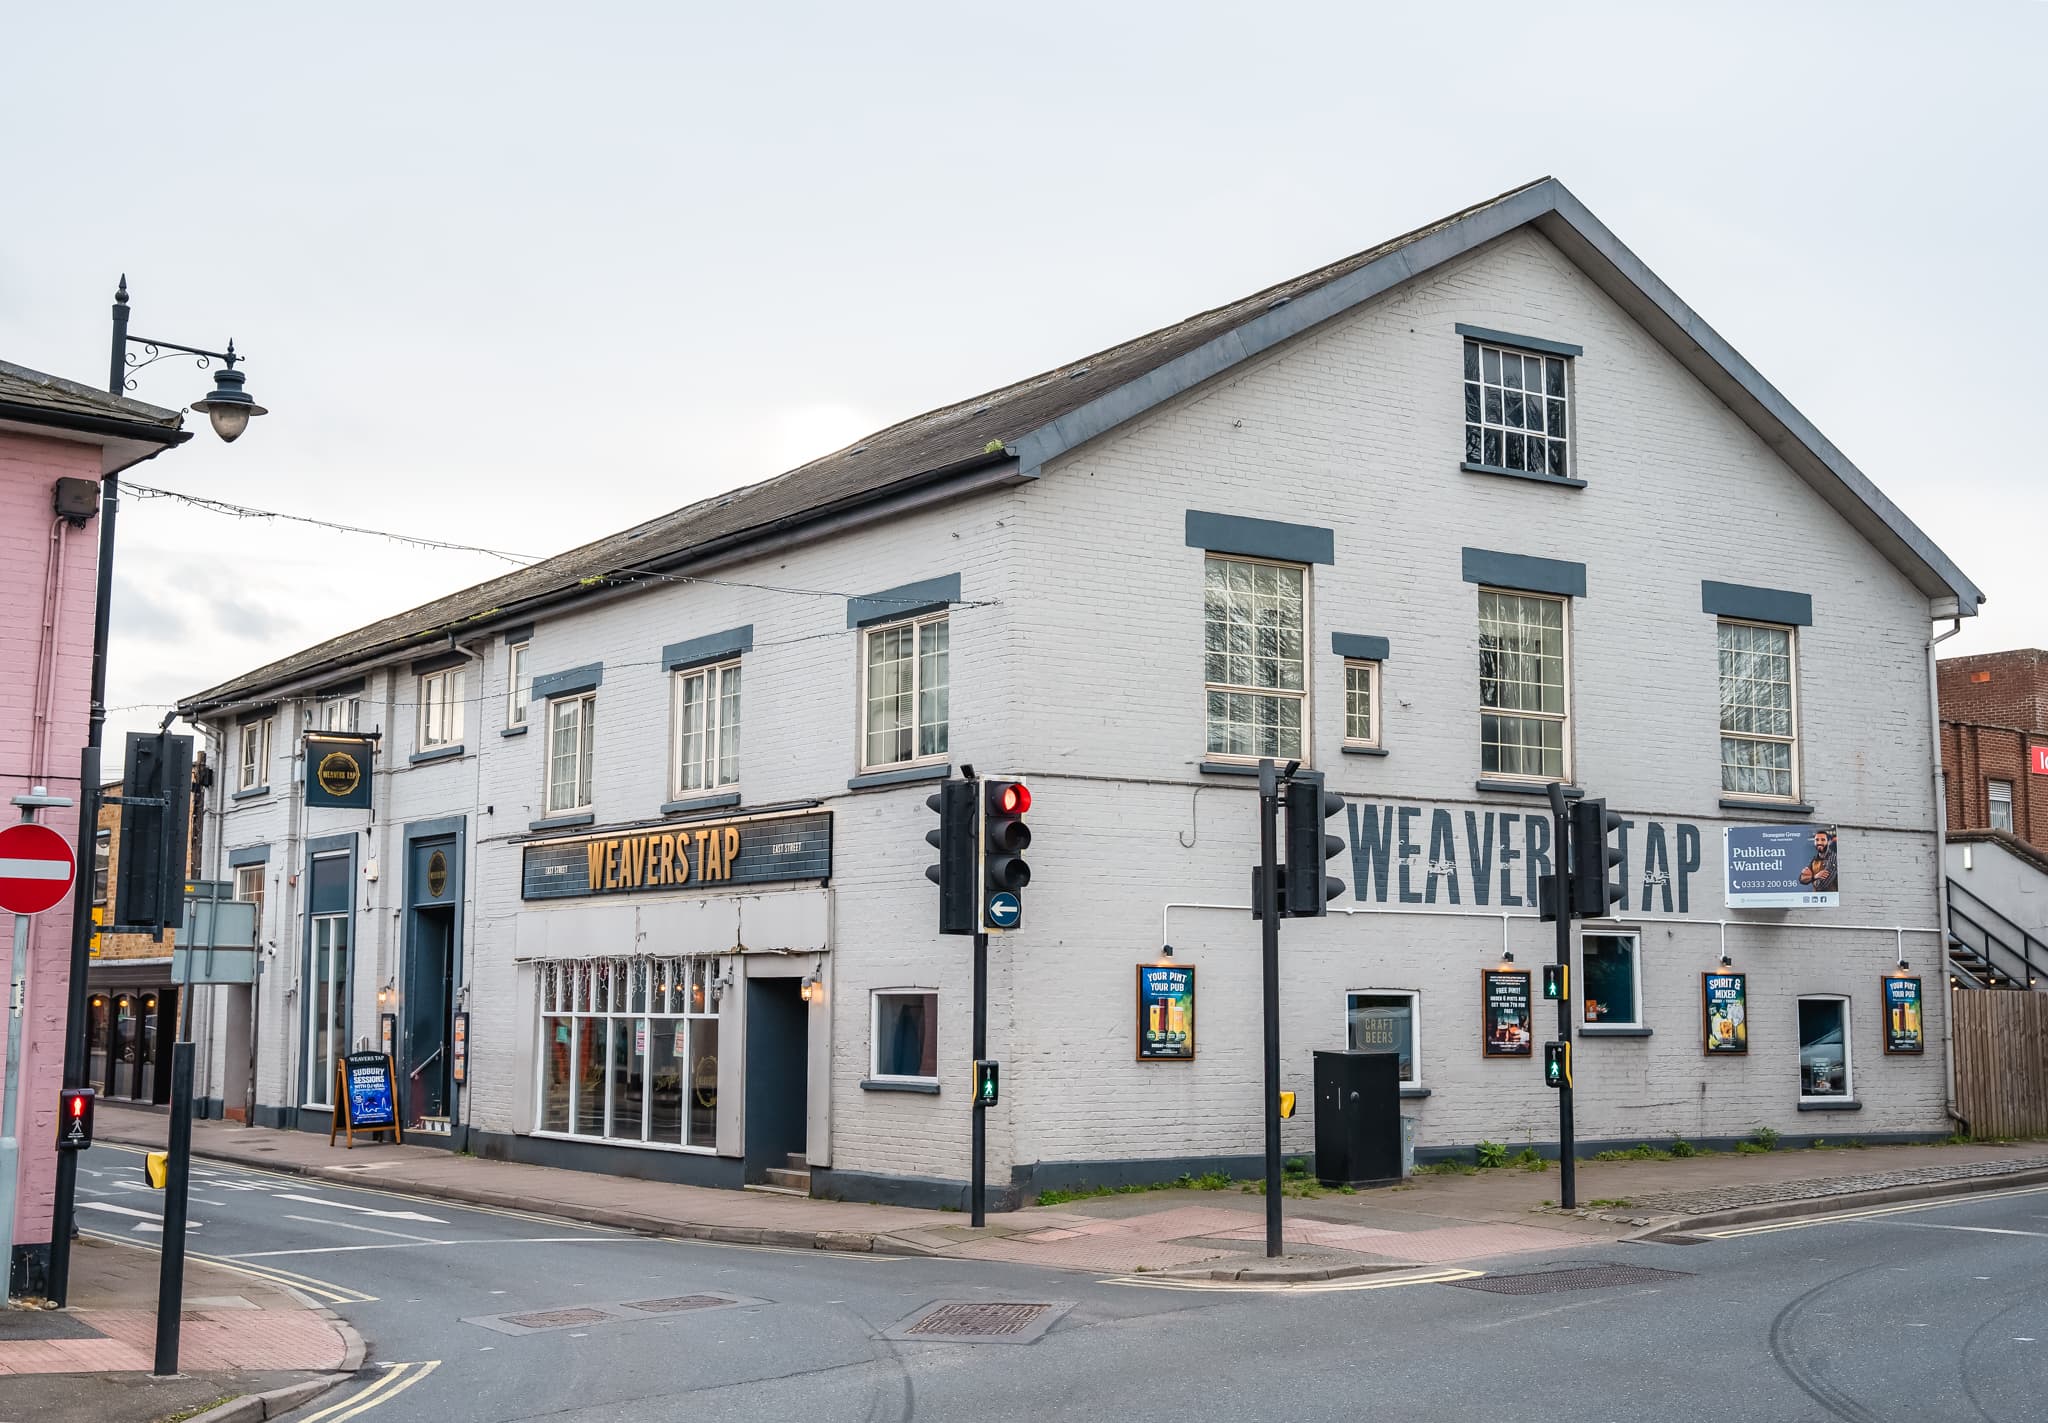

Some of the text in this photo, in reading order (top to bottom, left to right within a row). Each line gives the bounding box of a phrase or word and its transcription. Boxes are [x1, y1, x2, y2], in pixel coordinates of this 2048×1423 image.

[772, 842, 802, 854] EAST STREET
[1733, 846, 1786, 858] Publican
[587, 827, 740, 890] WEAVERS TAP
[1346, 803, 1700, 913] WEAVER TAP
[1733, 859, 1783, 872] Wanted!
[1741, 880, 1798, 888] 03333 200 036
[1147, 972, 1187, 983] YOUR PINT
[1150, 982, 1184, 992] YOUR PUB
[1709, 978, 1741, 990] SPIRIT &
[1715, 990, 1736, 998] MIXER
[1365, 1018, 1393, 1030] CRAFT
[1365, 1031, 1393, 1043] BEERS
[353, 1068, 384, 1076] SUDBURY
[353, 1076, 384, 1084] SESSIONS
